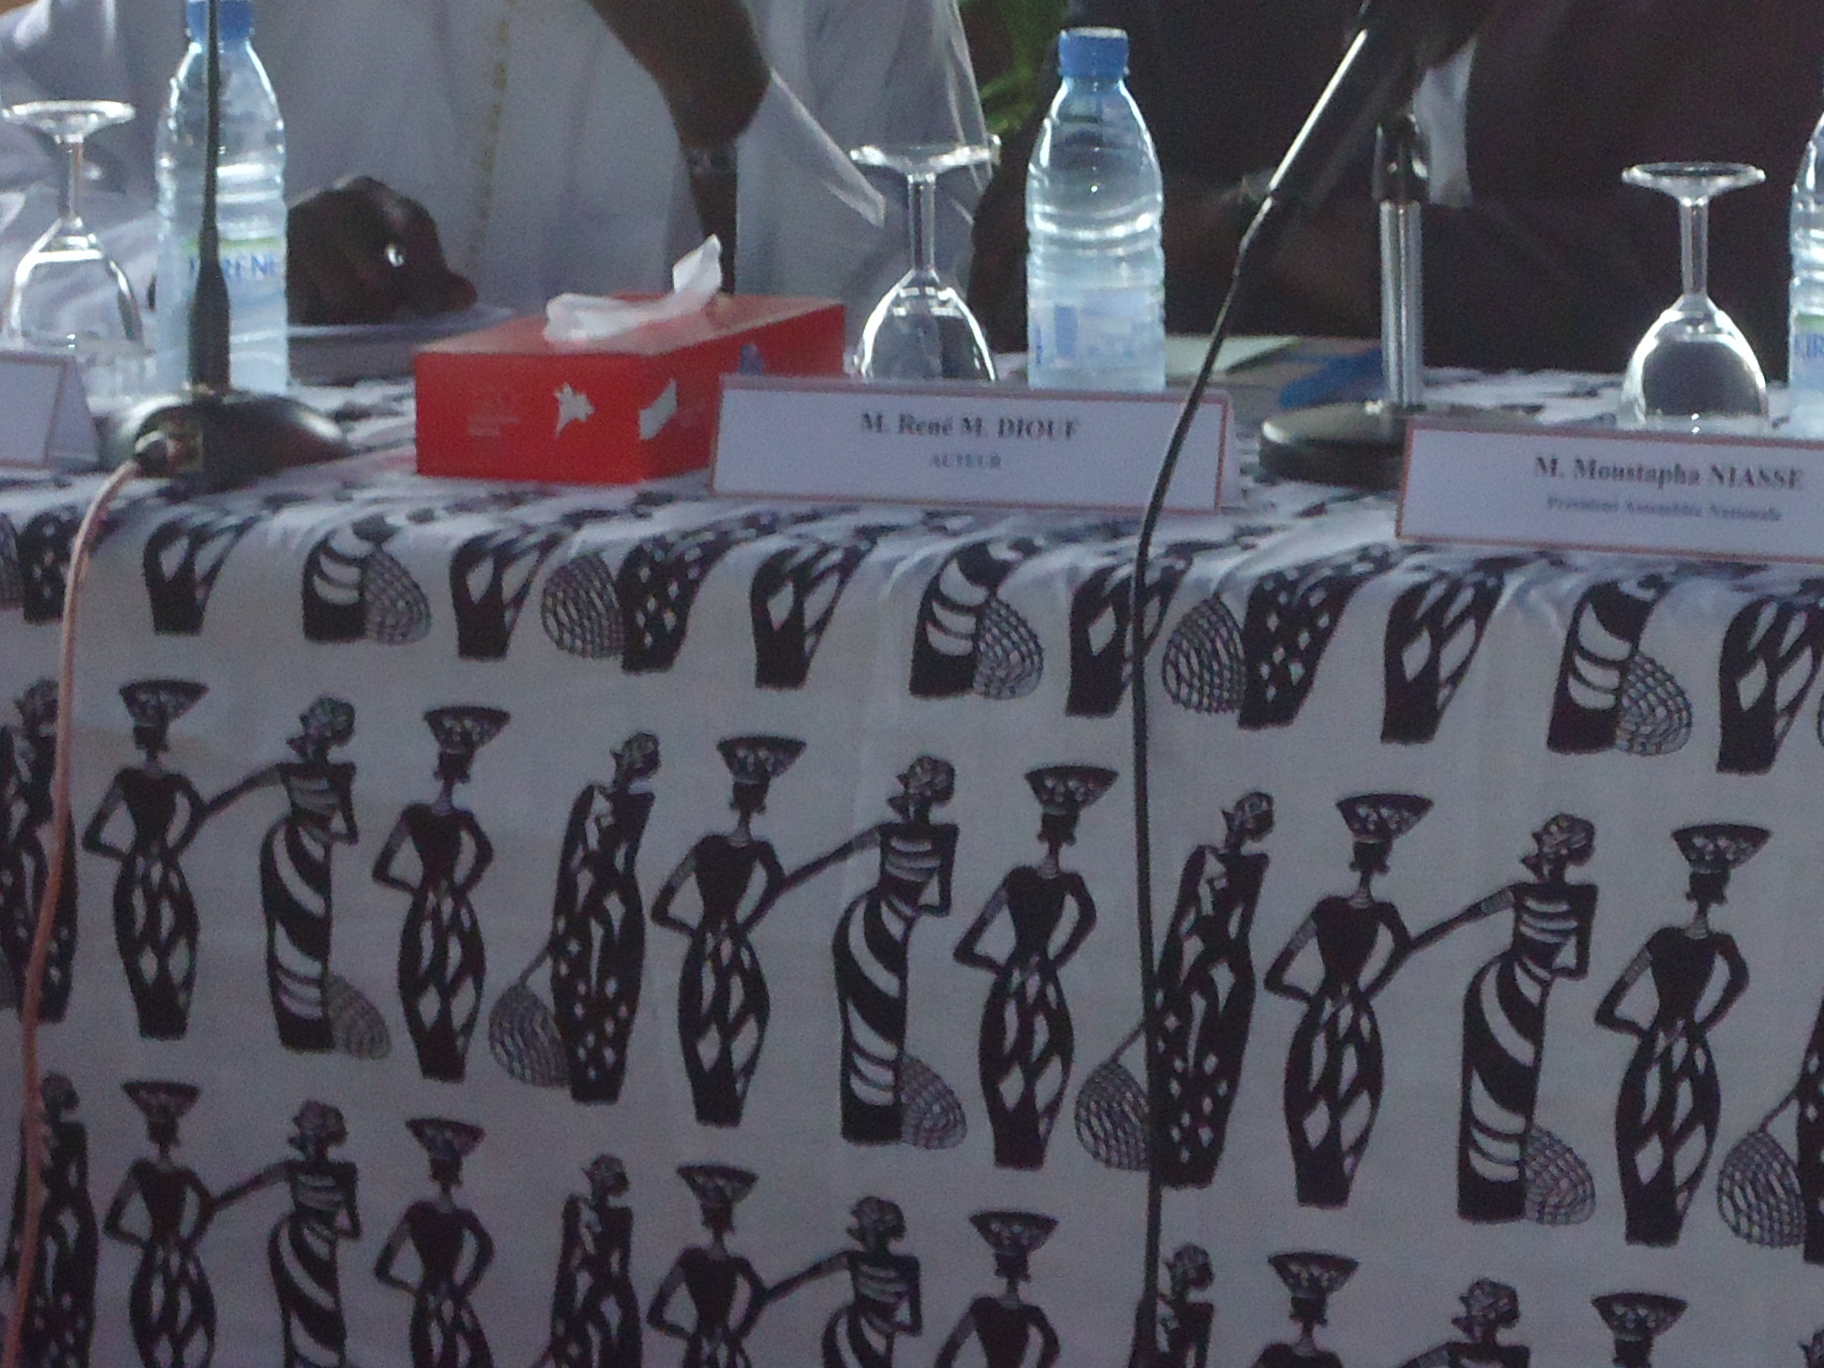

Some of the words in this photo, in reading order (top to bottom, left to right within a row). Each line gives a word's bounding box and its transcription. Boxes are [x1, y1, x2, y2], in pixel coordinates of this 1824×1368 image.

[897, 412, 953, 435] René
[997, 417, 1080, 440] DIOUF
[1536, 456, 1565, 479] M.
[1573, 458, 1701, 489] Moustapha
[1709, 464, 1804, 489] NIASSE
